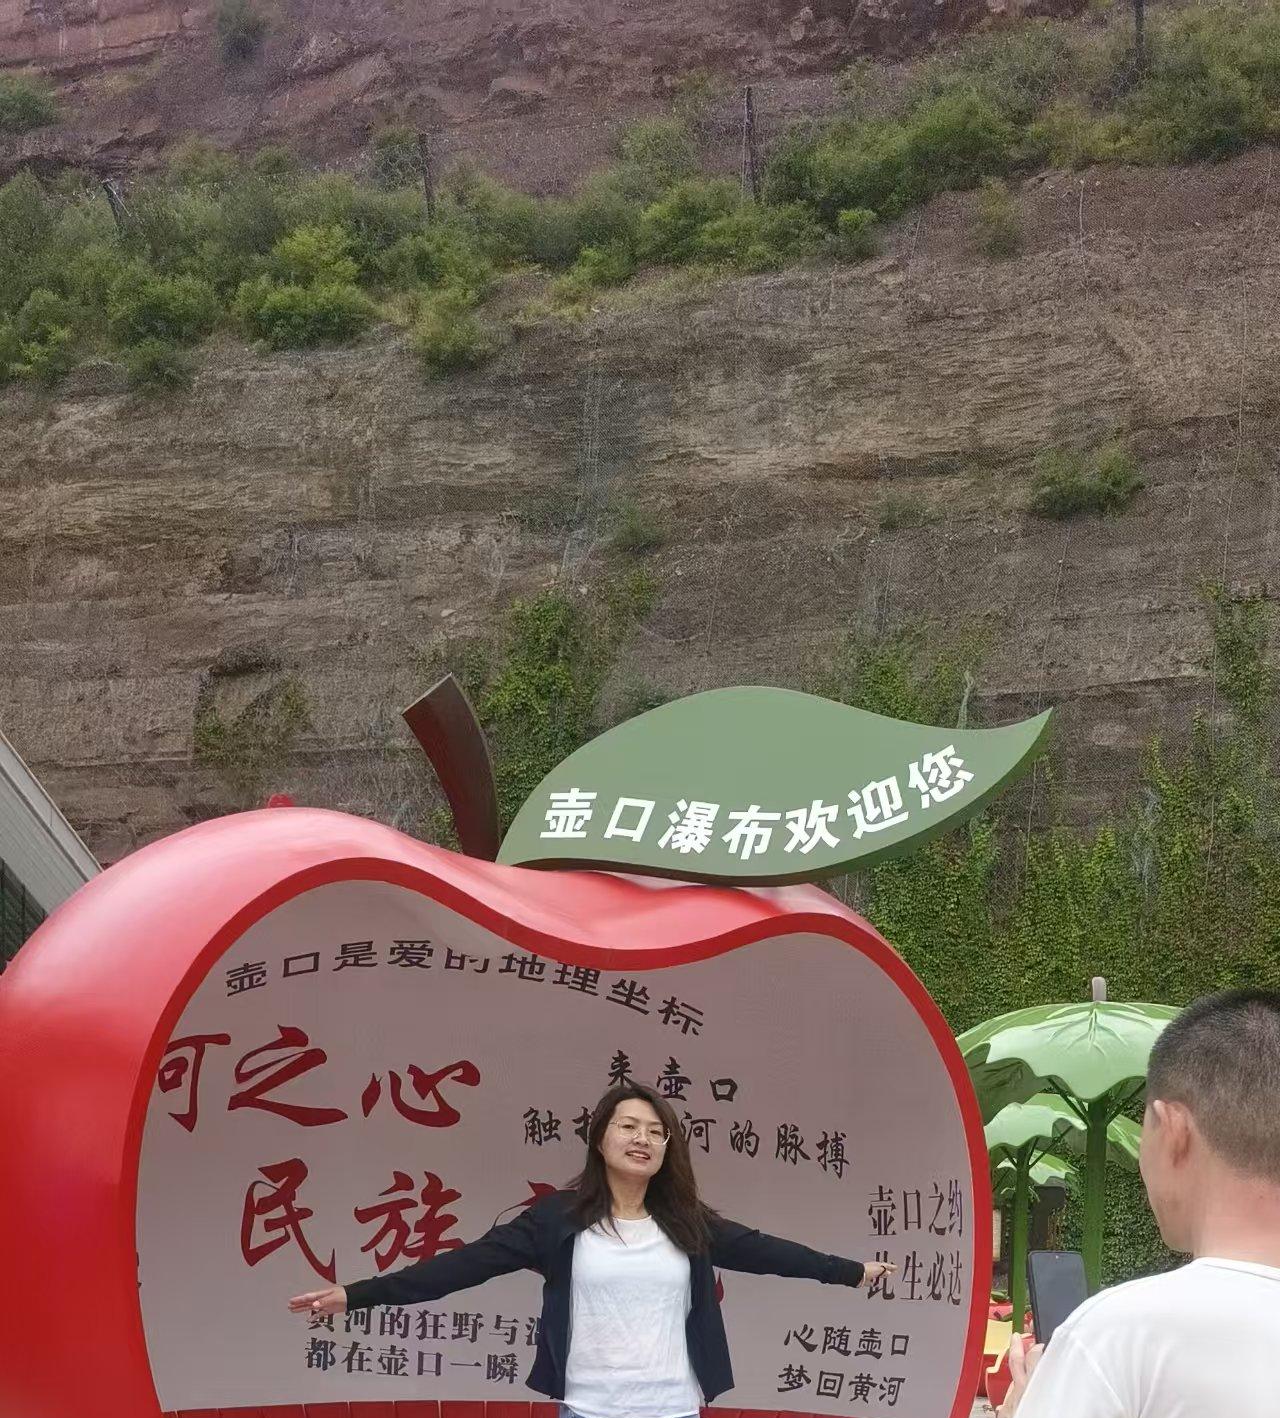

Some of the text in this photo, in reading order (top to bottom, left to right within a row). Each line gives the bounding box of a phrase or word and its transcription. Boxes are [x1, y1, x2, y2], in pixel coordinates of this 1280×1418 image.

[540, 744, 975, 860] 壶口瀑布欢迎您
[225, 938, 705, 1037] 壶口是爱的地理坐标
[607, 1049, 738, 1102] 来壶口
[522, 1105, 850, 1179] 触河的脉搏
[240, 1157, 582, 1285] 民族
[867, 1179, 963, 1237] 壶口之约
[867, 1250, 963, 1306] 此生必达
[307, 1305, 541, 1347] 河的狂野与
[783, 1323, 910, 1360] 心随壶口
[304, 1337, 520, 1384] 都在壶口一瞬
[777, 1363, 906, 1407] 梦回黄河
